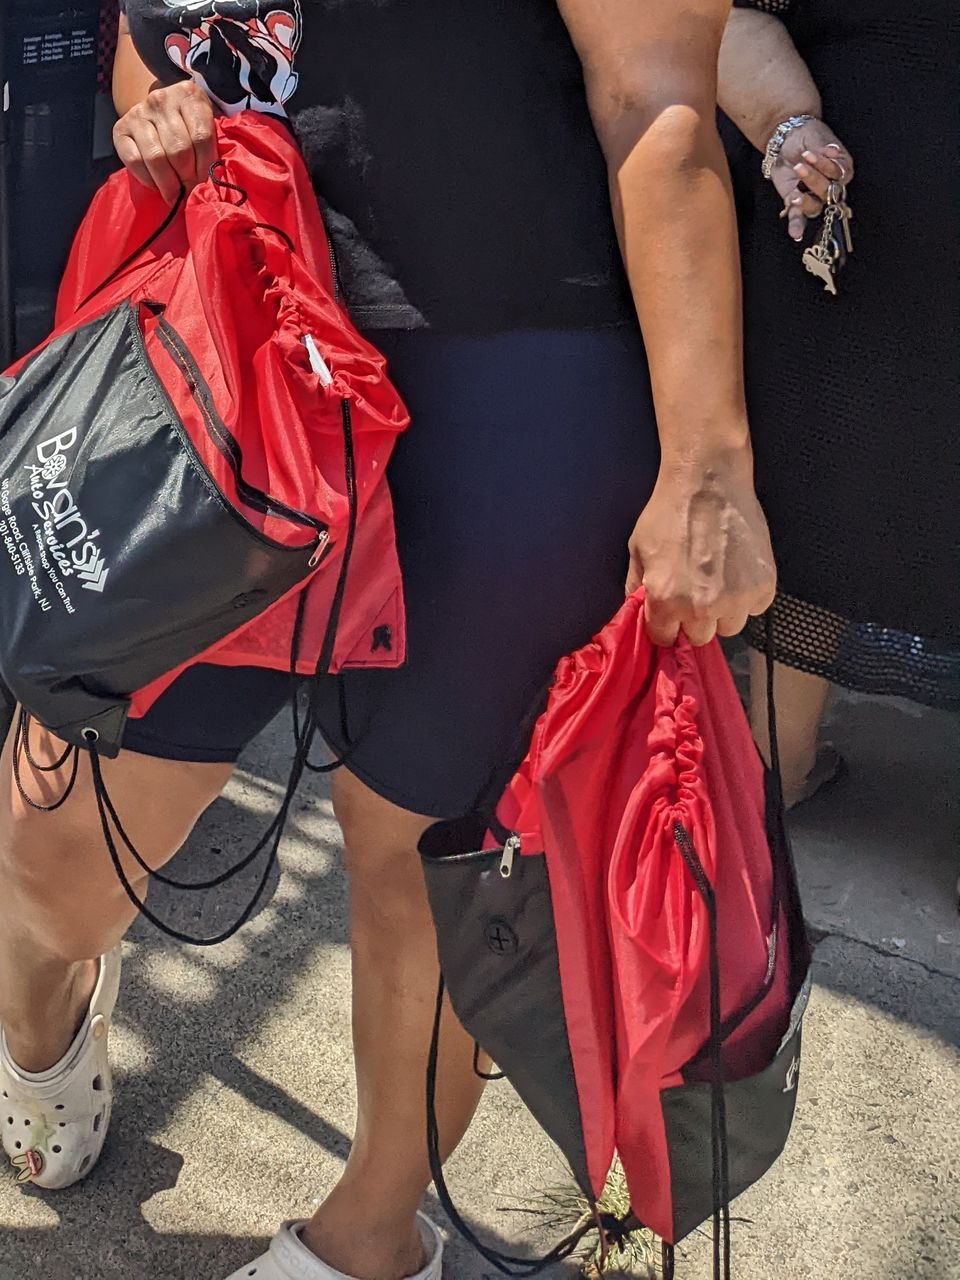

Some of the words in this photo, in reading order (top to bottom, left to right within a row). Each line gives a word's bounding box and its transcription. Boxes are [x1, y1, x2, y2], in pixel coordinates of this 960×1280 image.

[24, 464, 44, 500] Auto
[1, 490, 12, 516] Gorge
[19, 542, 35, 576] Cliffside
[38, 597, 52, 612] NJ
[31, 501, 74, 576] Services
[47, 567, 59, 583] You
[55, 581, 67, 599] Can
[63, 596, 76, 614] Trust
